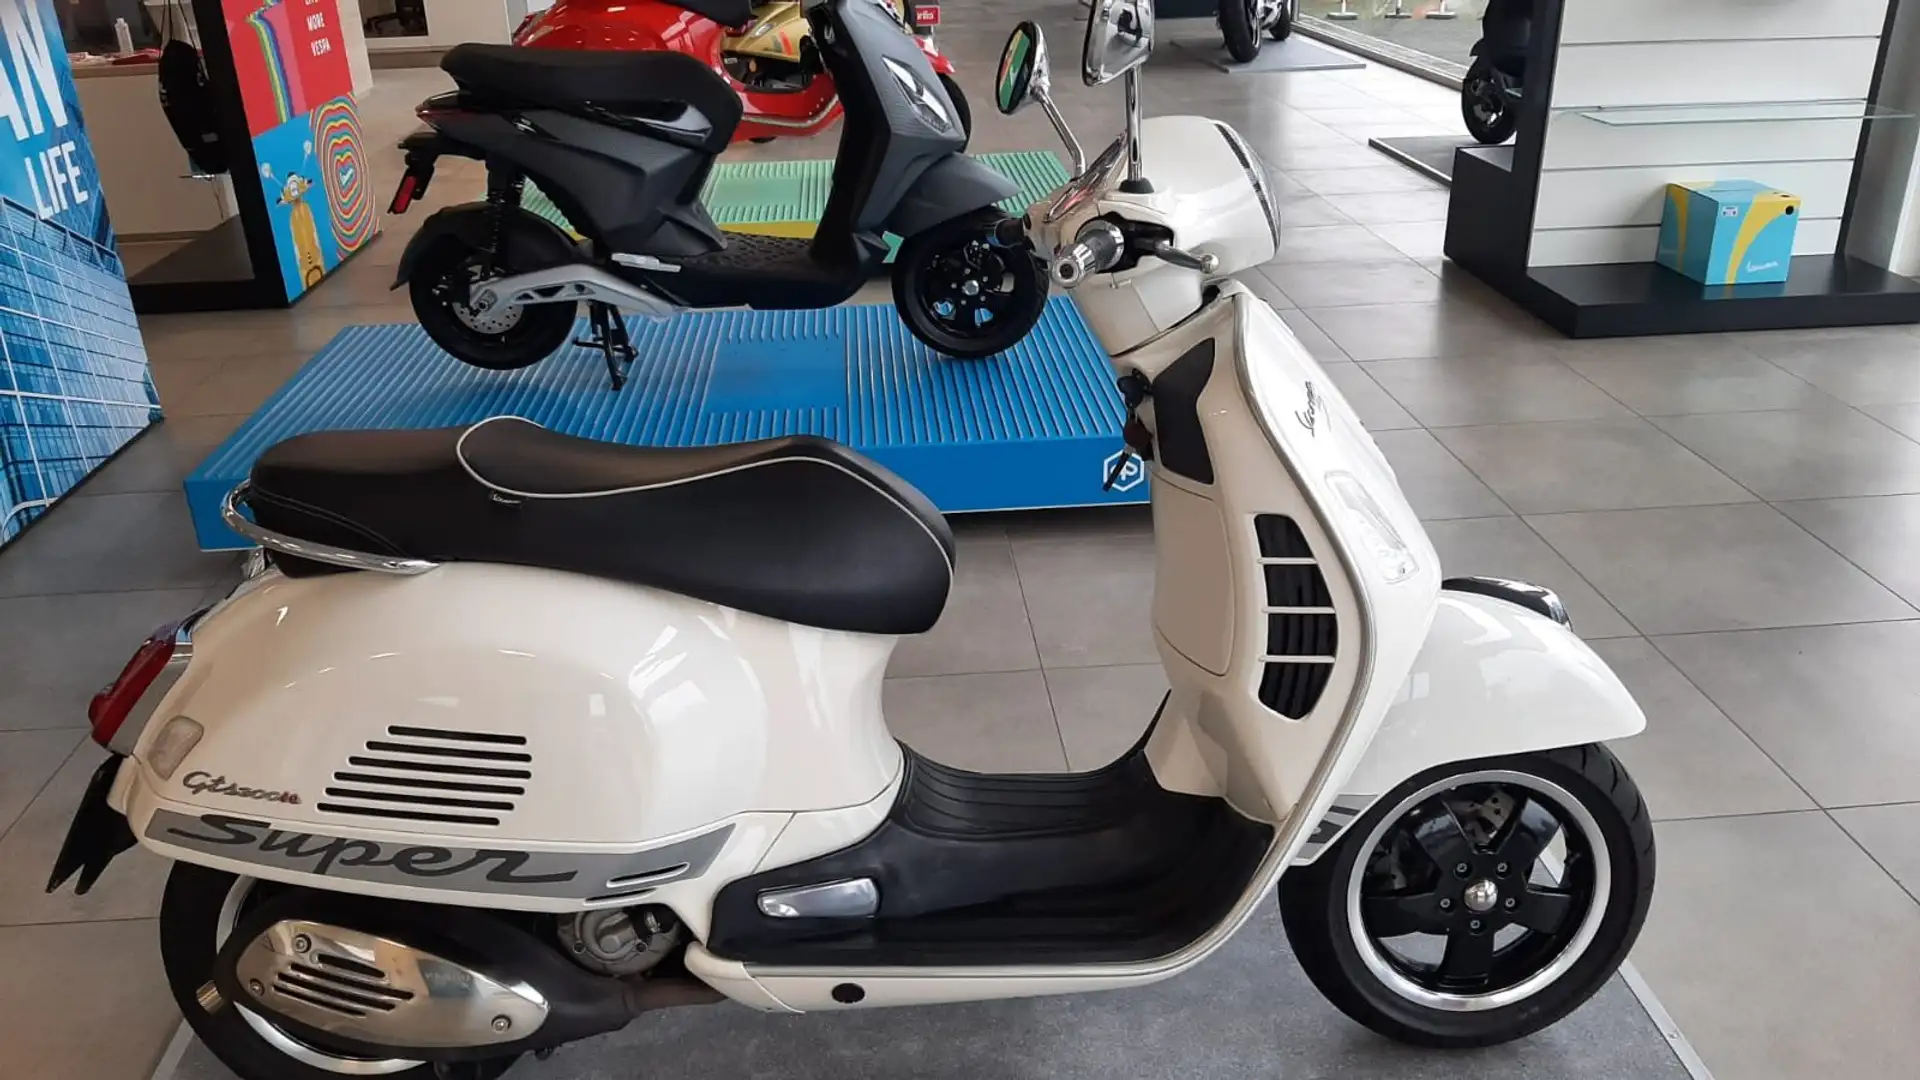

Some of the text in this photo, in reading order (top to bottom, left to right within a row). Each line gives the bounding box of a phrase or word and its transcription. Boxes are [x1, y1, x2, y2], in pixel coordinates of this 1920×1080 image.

[306, 12, 325, 31] MORE
[311, 37, 332, 57] VESPA
[24, 141, 89, 220] LIFE
[167, 813, 578, 884] Super
